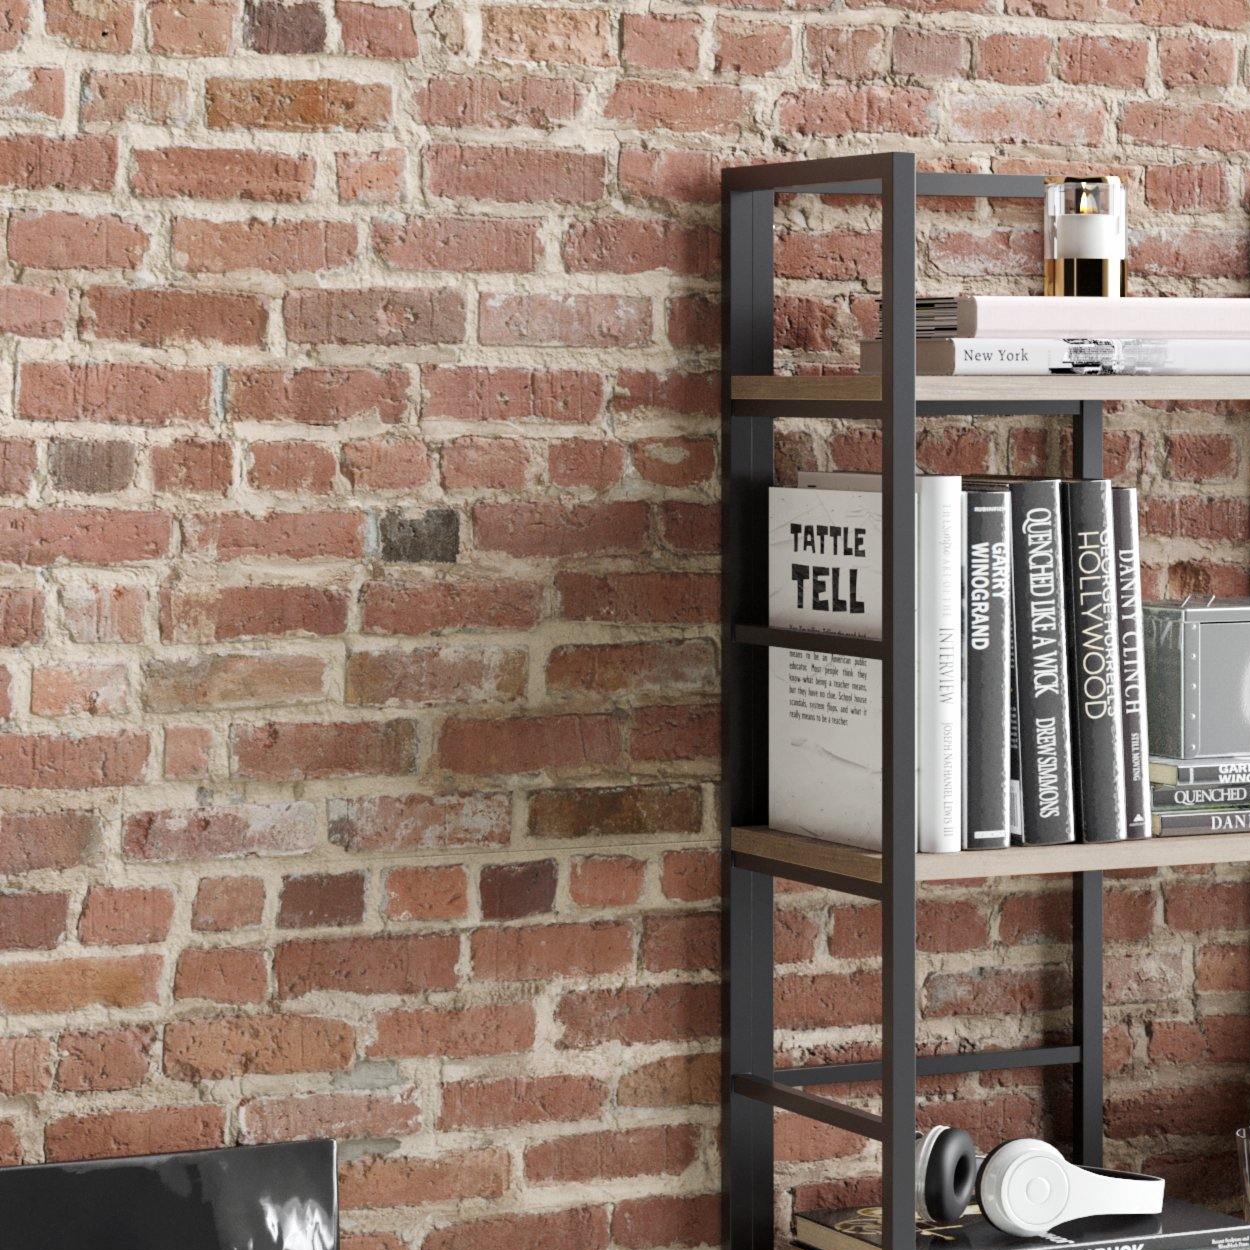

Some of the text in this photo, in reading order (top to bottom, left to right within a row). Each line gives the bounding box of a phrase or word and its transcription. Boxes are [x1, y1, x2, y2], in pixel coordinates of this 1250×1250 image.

[963, 347, 1029, 362] New York
[790, 523, 866, 557] TATTLE
[792, 563, 865, 613] TELL
[970, 542, 990, 651] WINOGRAND
[992, 541, 1008, 598] GARRY
[1118, 549, 1137, 622] DANNY
[1078, 531, 1107, 720] HOLLYWOOD
[938, 628, 954, 704] INTERVIEW
[1022, 507, 1060, 818] QUENCHED LIKE A WICK DREW SIMMONS
[1121, 631, 1140, 715] CLINCH
[943, 753, 953, 798] NATHANIEL
[1174, 786, 1247, 806] QUENCHED
[943, 800, 953, 825] LEWIS
